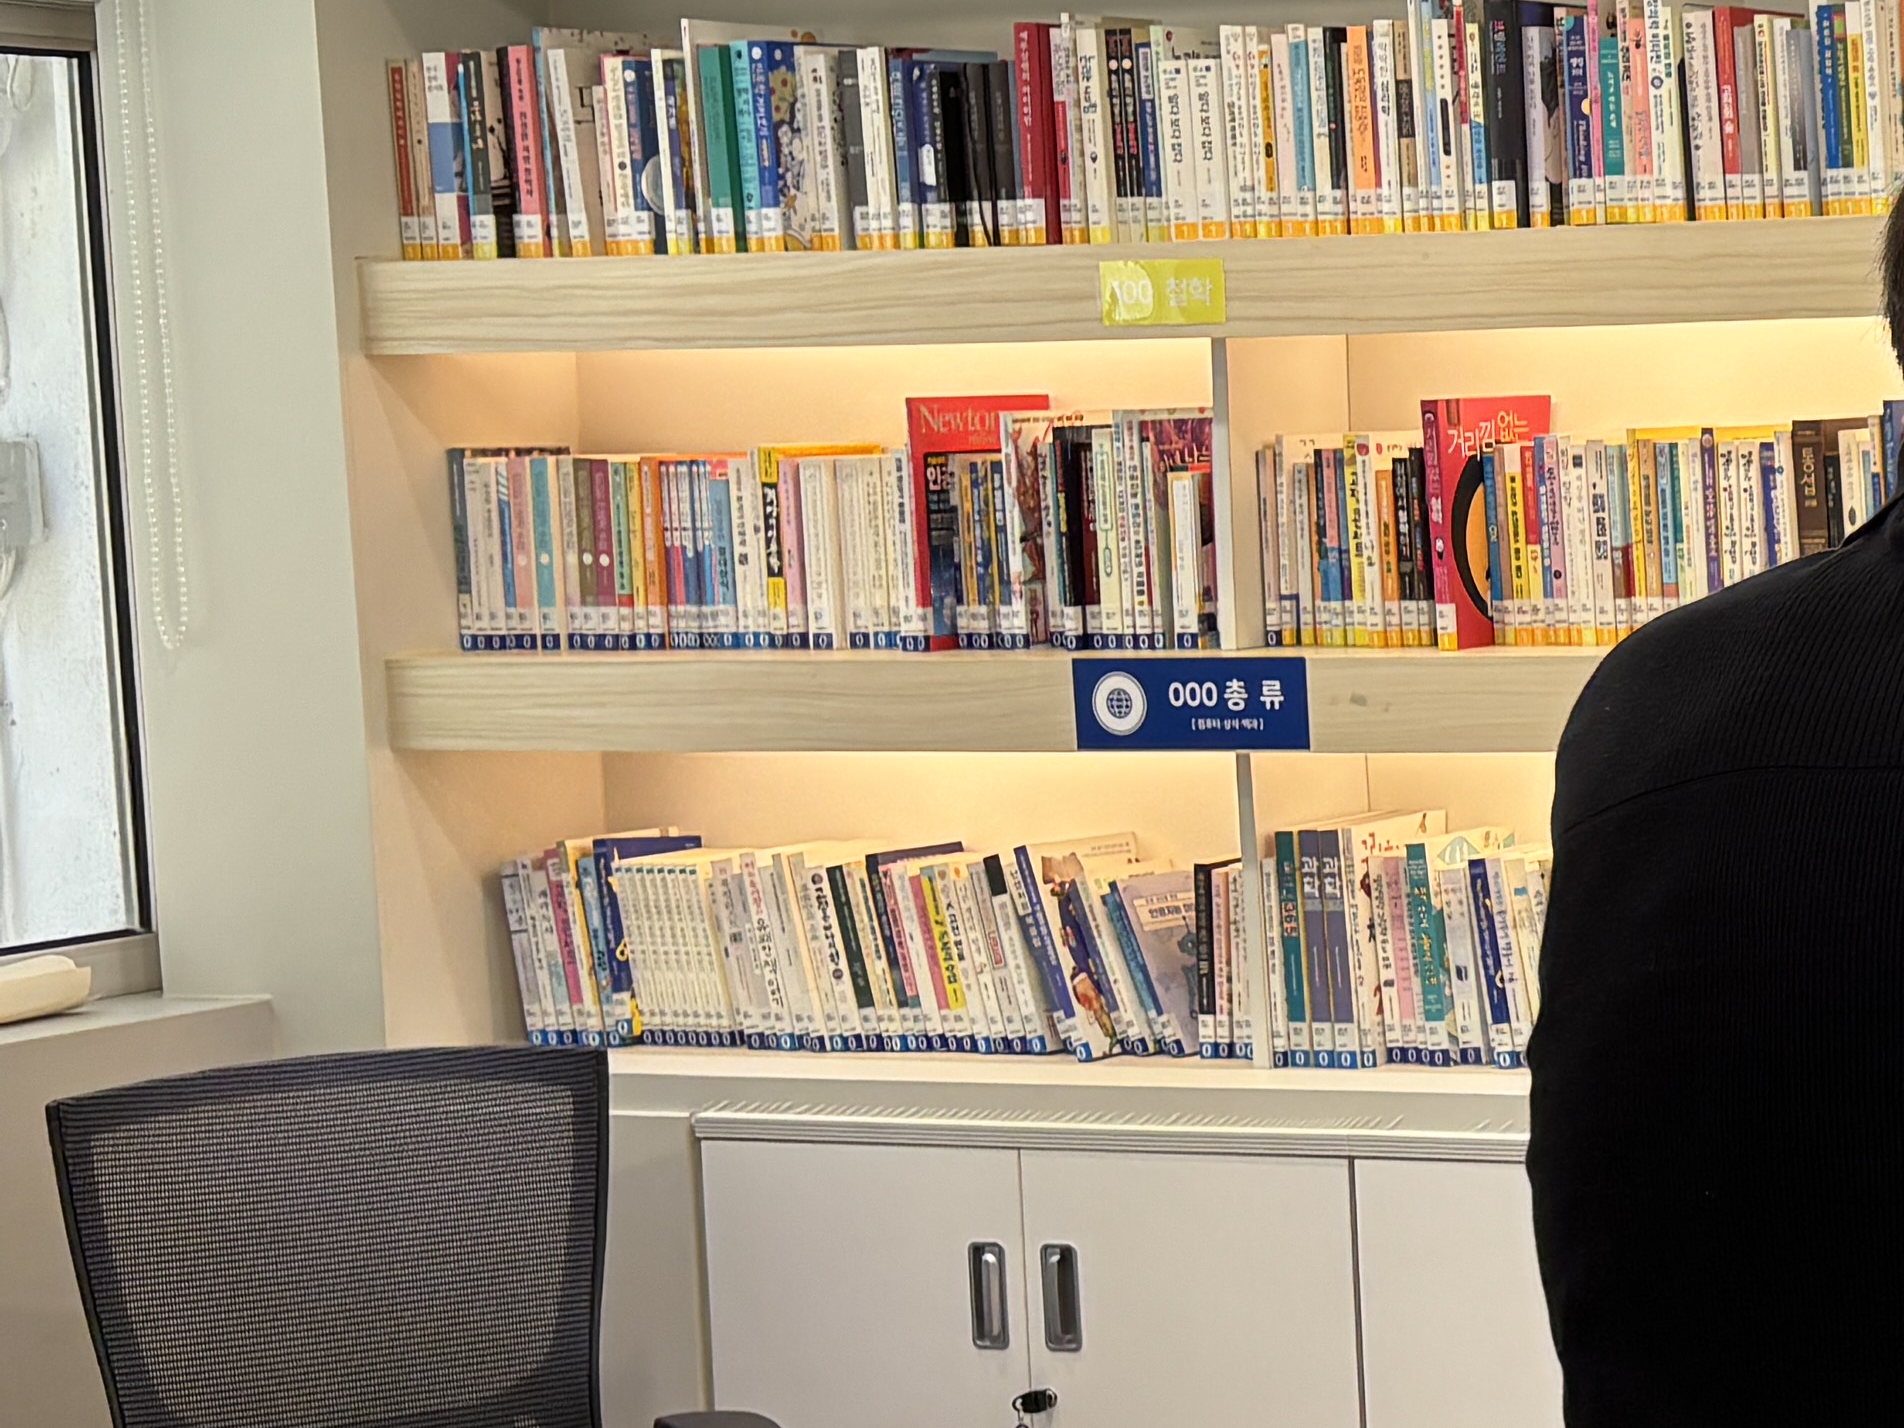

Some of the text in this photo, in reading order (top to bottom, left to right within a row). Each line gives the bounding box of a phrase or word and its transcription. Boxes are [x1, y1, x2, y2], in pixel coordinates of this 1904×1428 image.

[1446, 417, 1497, 458] 거리낌
[1801, 447, 1817, 496] 통섭
[1168, 681, 1218, 708] 000
